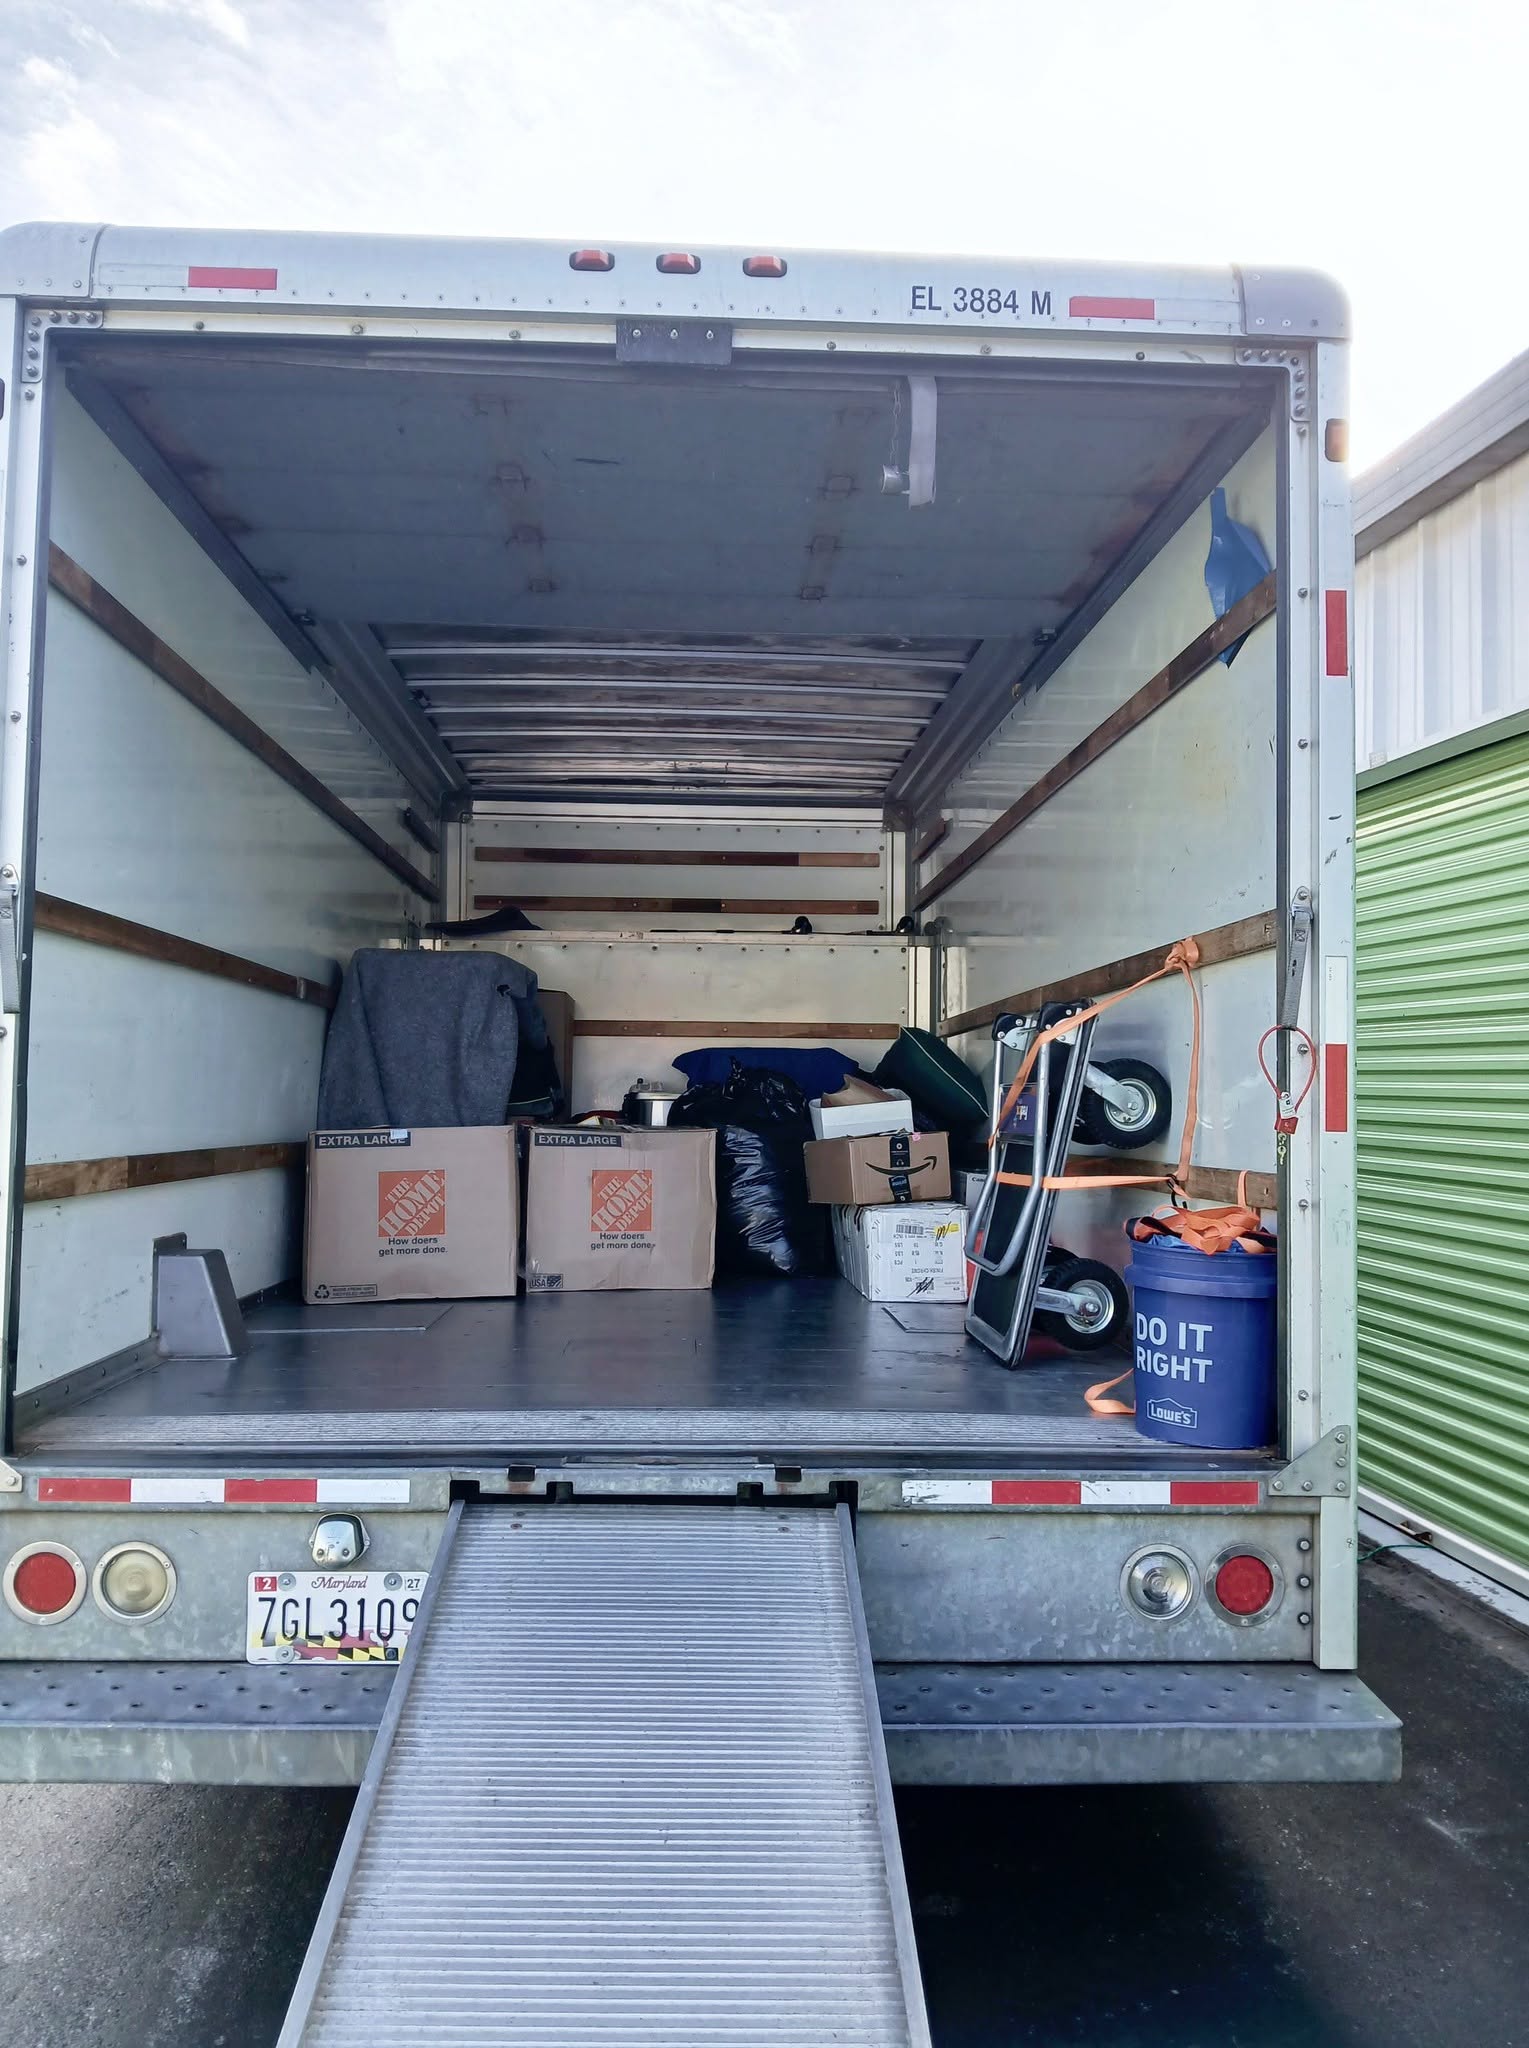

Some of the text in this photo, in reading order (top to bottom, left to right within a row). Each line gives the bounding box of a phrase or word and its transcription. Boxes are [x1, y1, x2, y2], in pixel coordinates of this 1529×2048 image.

[911, 285, 1051, 316] EL 3884 M
[319, 1135, 360, 1146] EXTRA
[539, 1135, 617, 1145] EXTRA LARGE
[384, 1177, 413, 1204] THE
[597, 1176, 624, 1202] THE
[378, 1169, 446, 1236] HOME
[590, 1169, 653, 1231] HOME
[404, 1193, 446, 1236] DEPOT
[615, 1192, 652, 1231] DEPOT
[388, 1236, 438, 1245] How doers
[600, 1232, 645, 1240] How doers
[378, 1245, 448, 1257] get more done.
[590, 1242, 605, 1250] get
[531, 1278, 546, 1287] USA
[1136, 1312, 1213, 1352] DO IT
[1136, 1345, 1213, 1383] RIGHT
[1150, 1403, 1192, 1425] LOWE'S
[262, 1577, 272, 1590] 2
[311, 1576, 369, 1592] Maryland
[407, 1578, 420, 1588] 27
